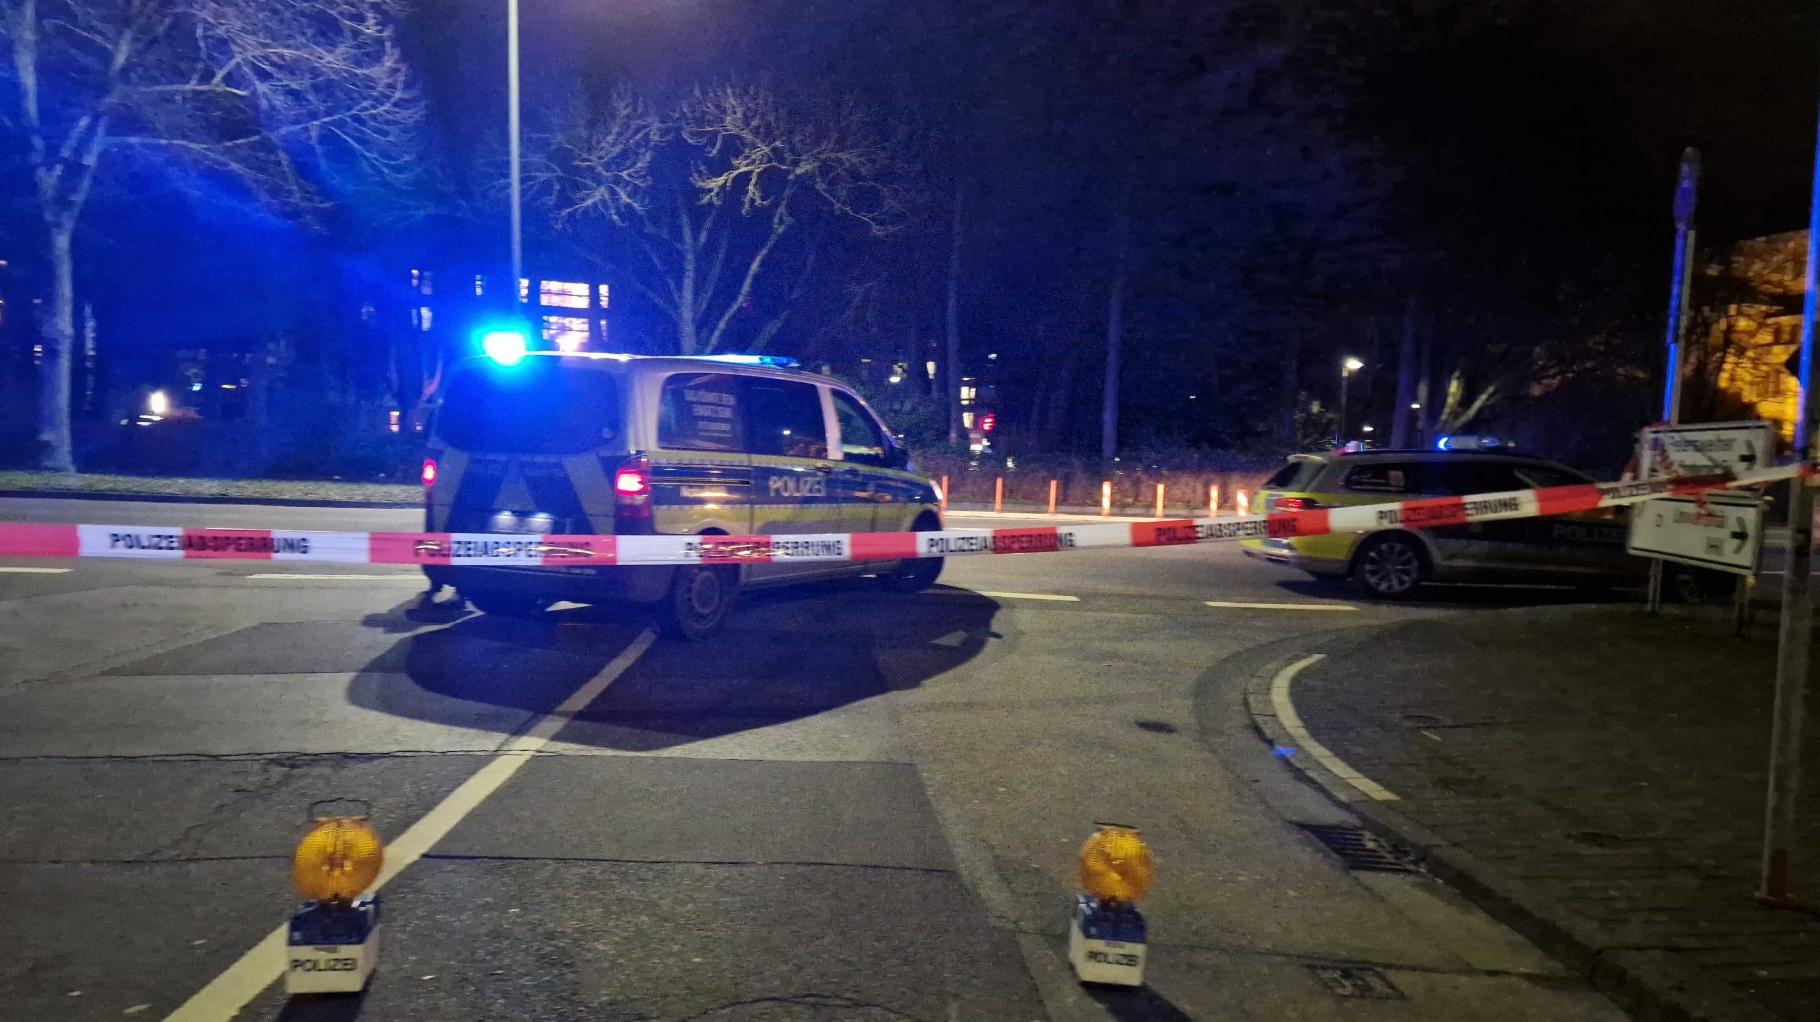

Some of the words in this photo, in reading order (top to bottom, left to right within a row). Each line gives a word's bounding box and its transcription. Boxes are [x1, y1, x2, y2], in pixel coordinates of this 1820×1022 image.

[1552, 523, 1627, 542] POLIZE
[110, 533, 309, 553] POLIZEIABSPERRUNG
[684, 540, 842, 557] POPERRUNG
